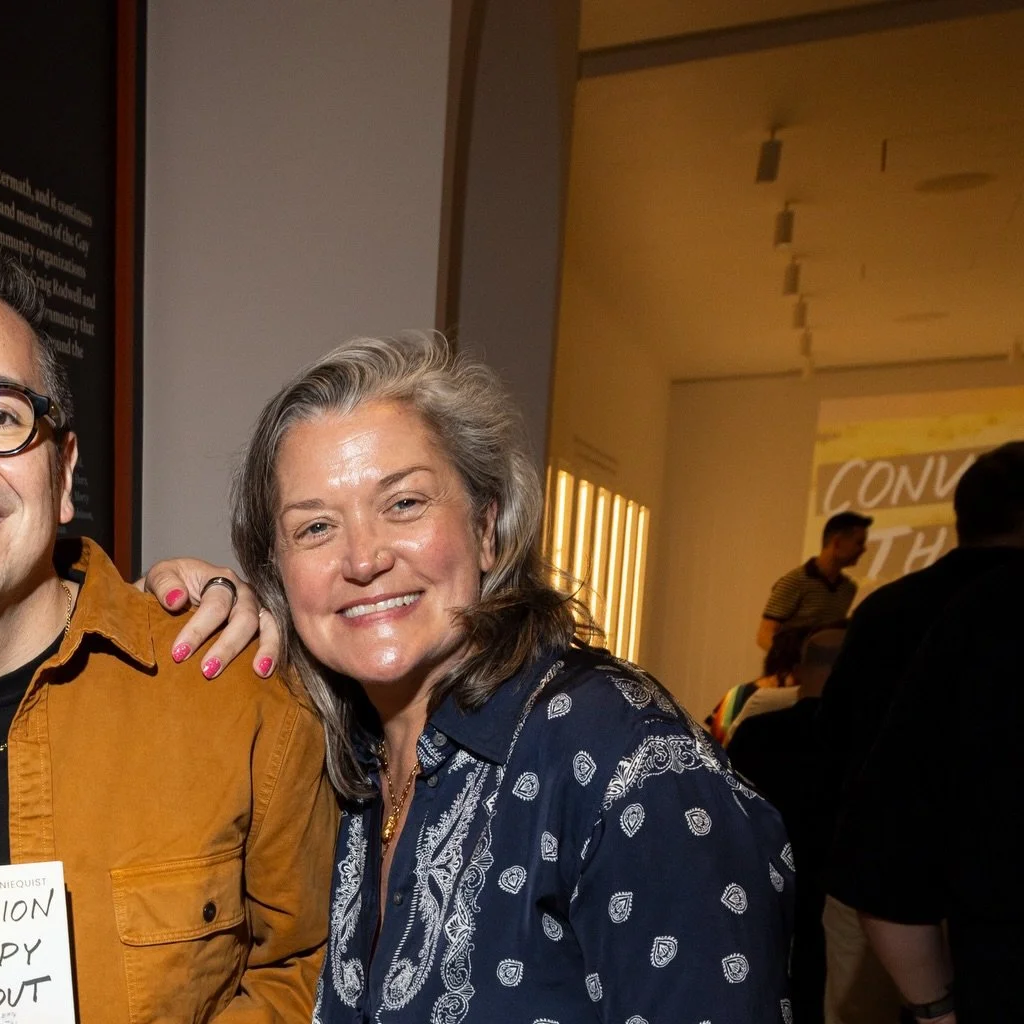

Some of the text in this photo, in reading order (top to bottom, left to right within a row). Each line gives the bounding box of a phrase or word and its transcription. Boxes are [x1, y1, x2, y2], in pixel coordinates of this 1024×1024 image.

[0, 200, 15, 220] and
[17, 209, 54, 238] members
[823, 454, 976, 516] CONV
